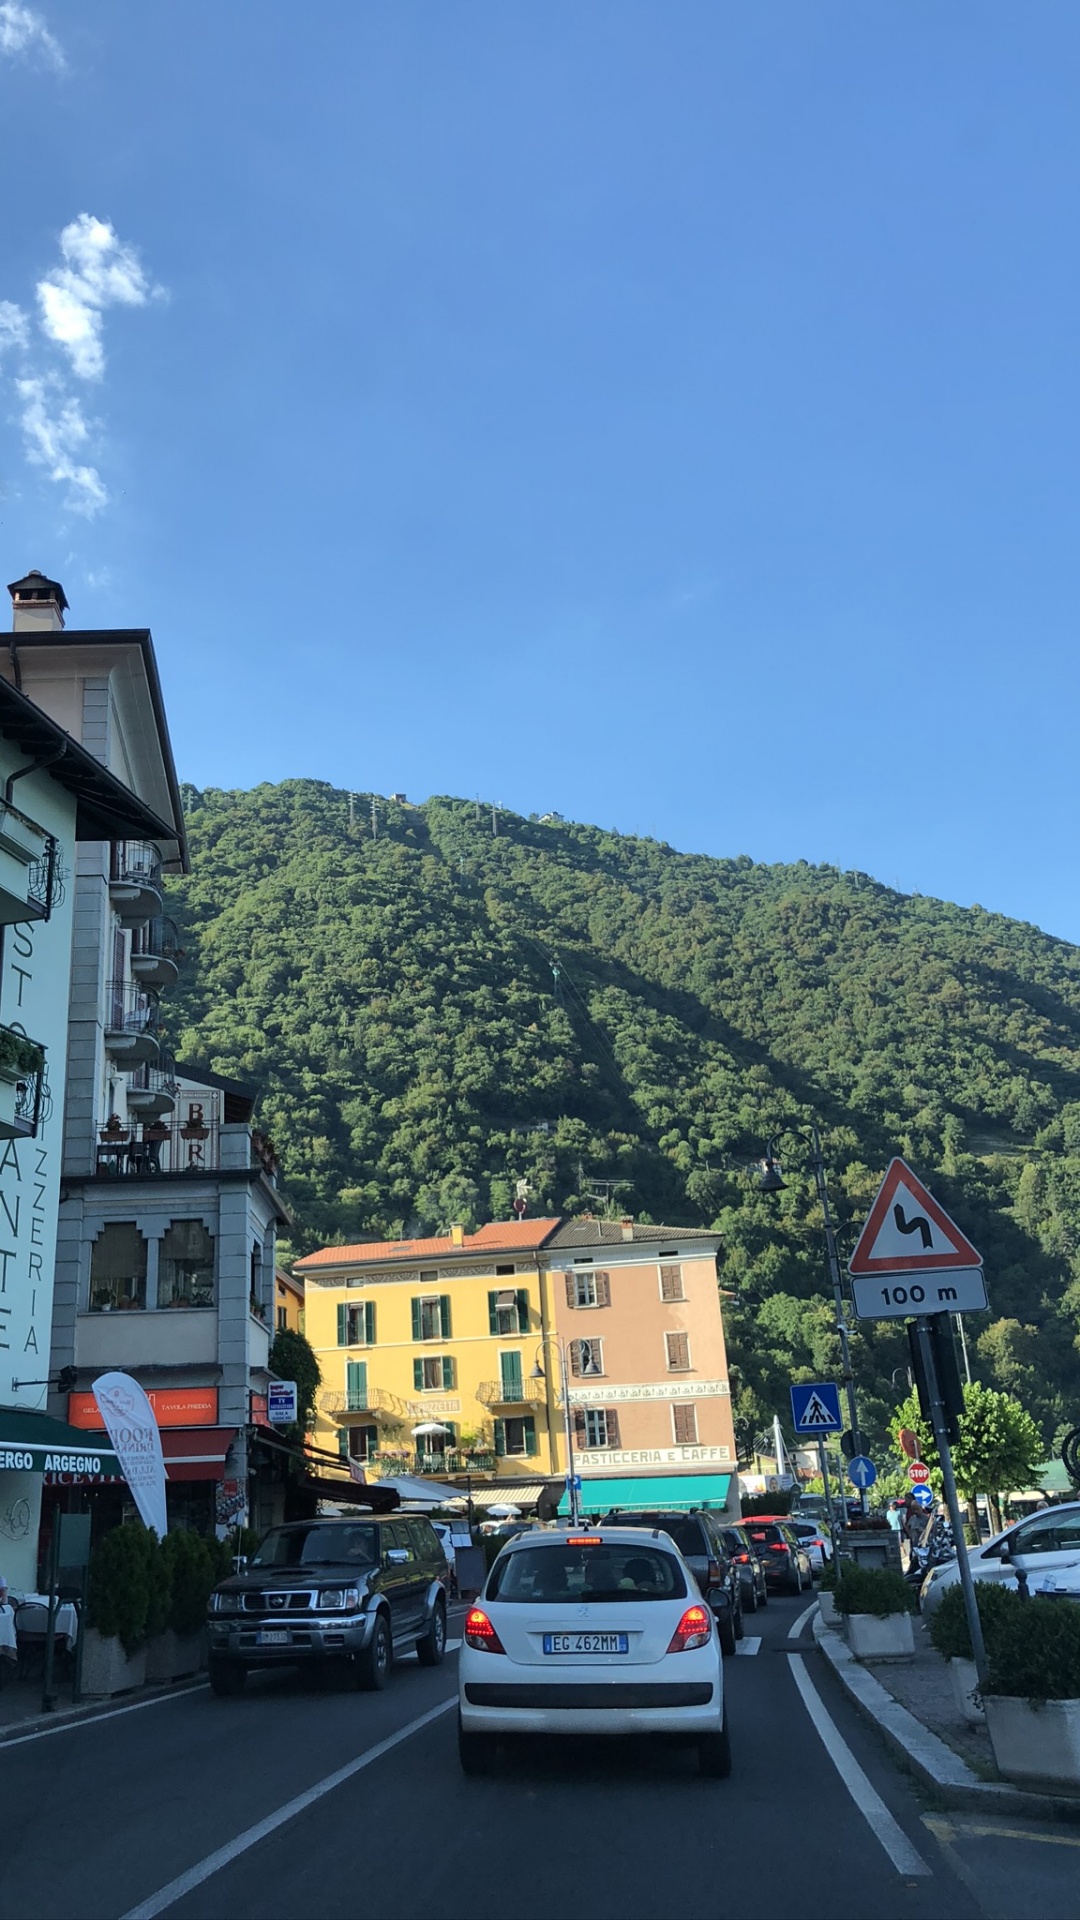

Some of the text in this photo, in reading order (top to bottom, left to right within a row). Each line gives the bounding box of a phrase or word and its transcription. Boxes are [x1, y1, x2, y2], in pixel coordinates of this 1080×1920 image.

[881, 1285, 957, 1305] 100 m
[418, 1401, 458, 1413] PIAZZETTA
[0, 1450, 101, 1474] ERGO ARGEGNO
[573, 1450, 662, 1466] PASTICCERIA
[909, 1469, 928, 1478] STOP
[553, 1636, 570, 1650] EG
[575, 1636, 618, 1650] 462MM
